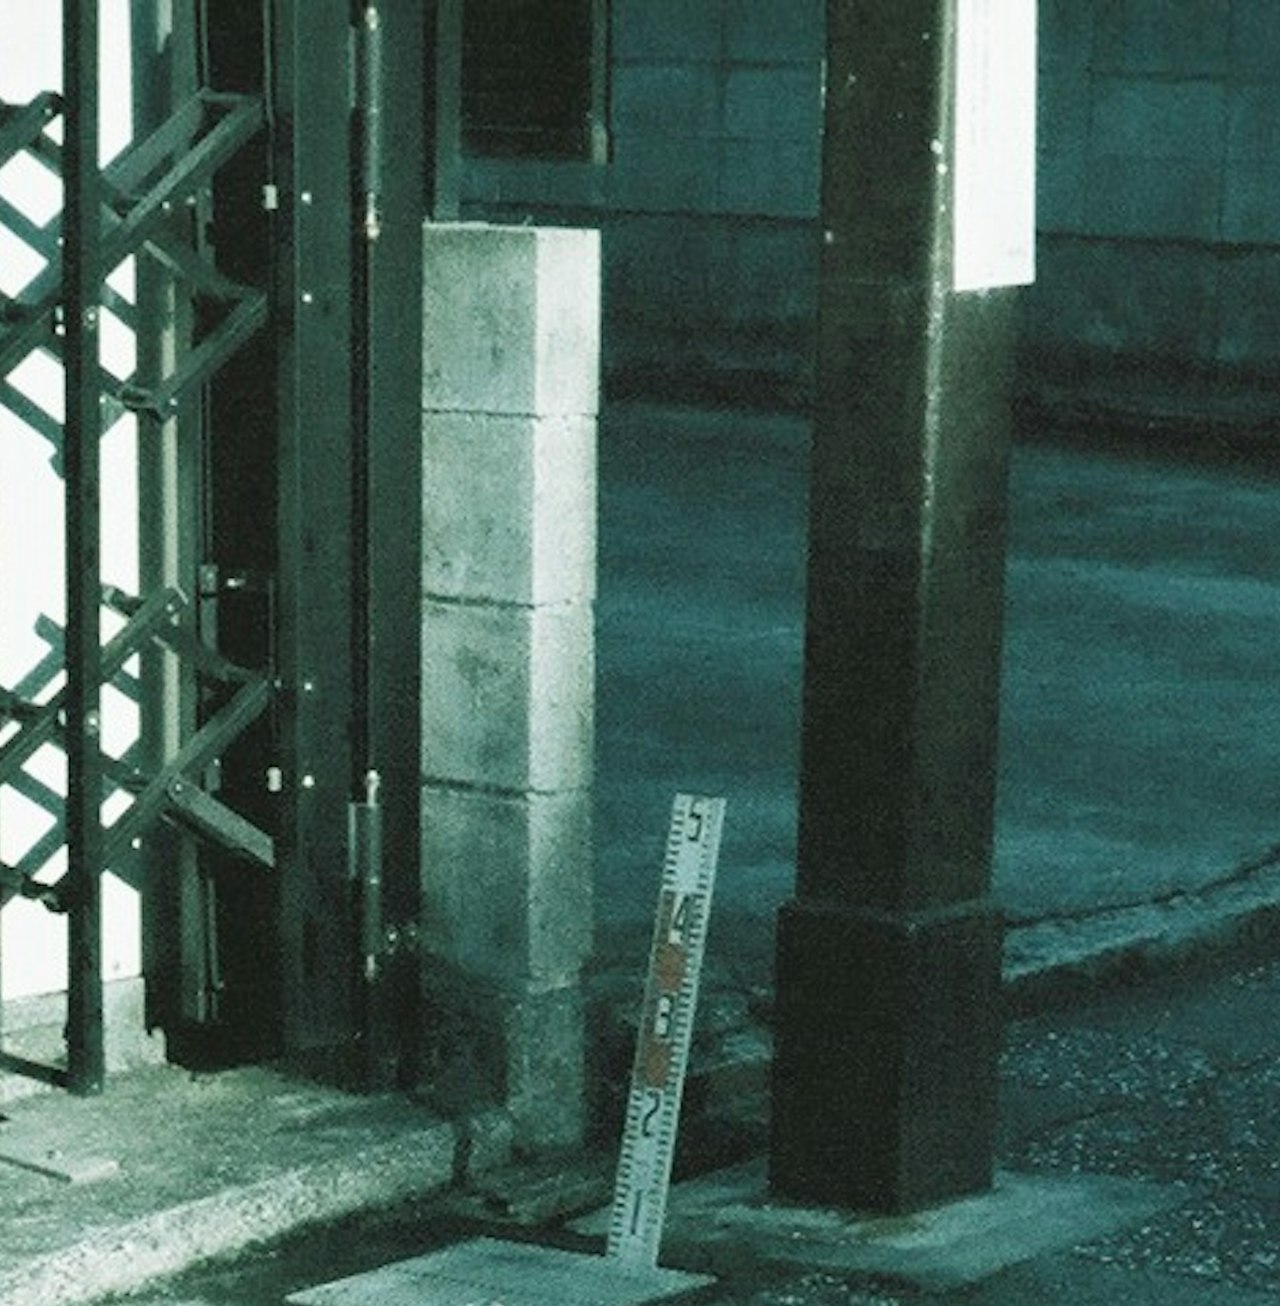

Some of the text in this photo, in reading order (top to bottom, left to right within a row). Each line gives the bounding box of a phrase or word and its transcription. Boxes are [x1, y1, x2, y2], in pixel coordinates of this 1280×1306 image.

[672, 894, 694, 942] 4
[659, 994, 676, 1039] 3
[641, 1090, 662, 1138] 2
[630, 1190, 644, 1236] 1
